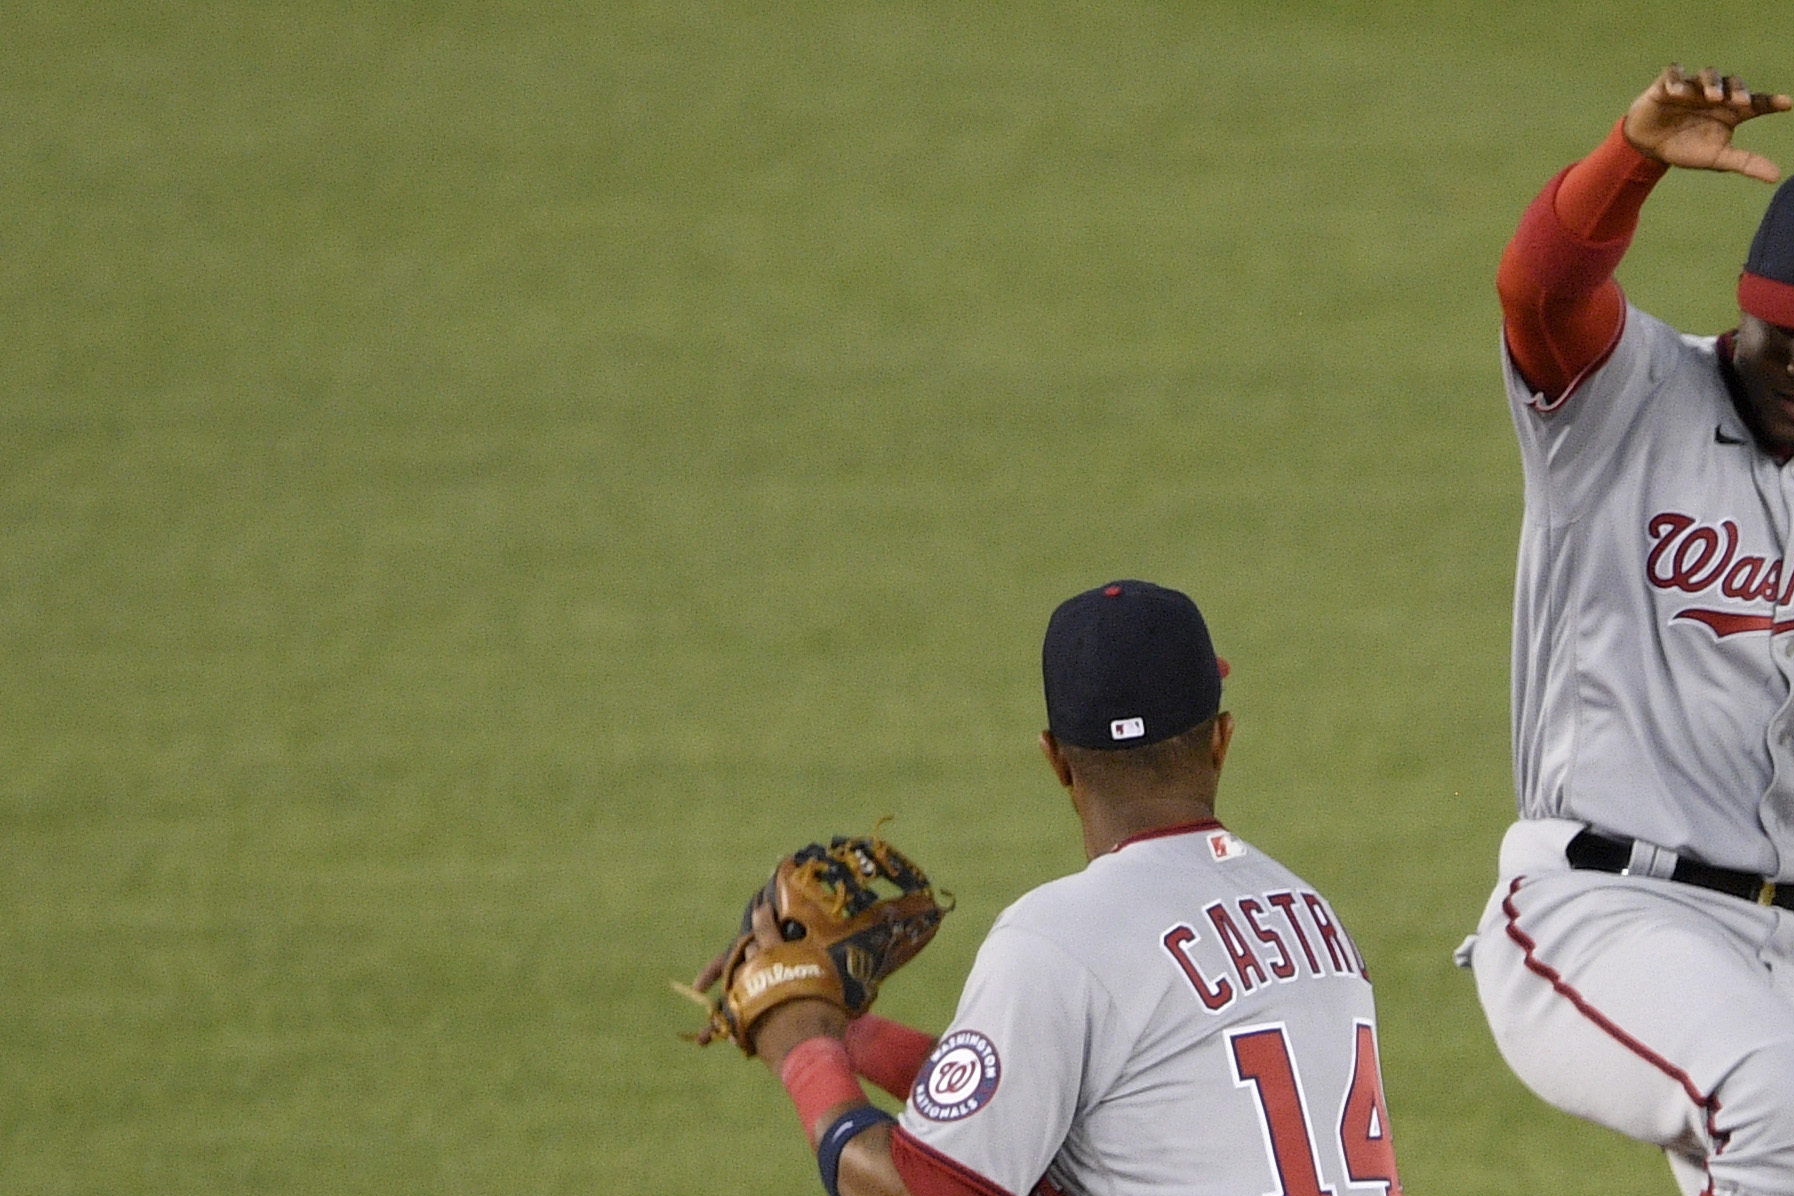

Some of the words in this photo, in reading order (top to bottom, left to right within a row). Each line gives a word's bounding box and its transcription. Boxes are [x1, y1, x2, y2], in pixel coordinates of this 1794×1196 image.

[1160, 888, 1373, 1014] CASTR
[745, 962, 825, 998] Wilson
[930, 1032, 997, 1079] WASHINGTON
[935, 1060, 977, 1094] W
[915, 1084, 979, 1119] NATIONALS
